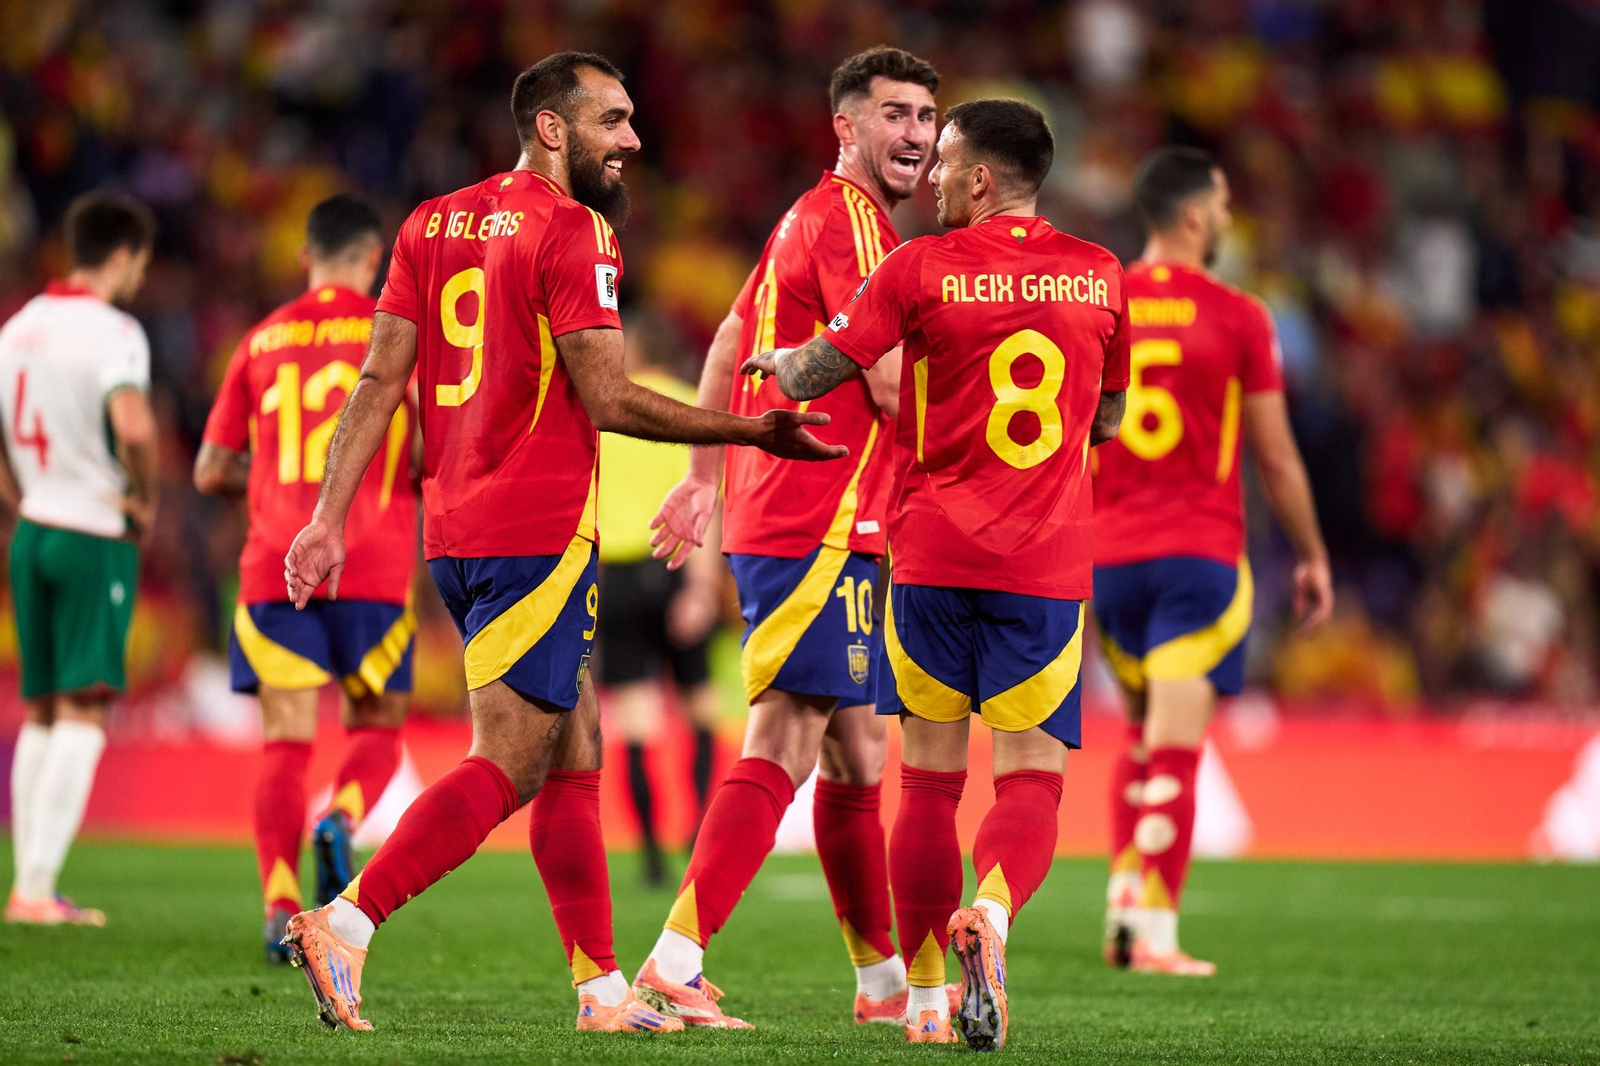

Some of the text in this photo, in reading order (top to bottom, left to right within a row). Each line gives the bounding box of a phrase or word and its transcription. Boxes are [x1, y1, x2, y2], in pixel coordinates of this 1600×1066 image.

[425, 212, 442, 238] B
[436, 267, 485, 407] 9
[942, 269, 1108, 307] ALEIX GARCÍA
[13, 366, 50, 474] 4
[261, 361, 361, 484] 12
[985, 328, 1066, 470] 8
[1117, 338, 1184, 461] 6
[583, 582, 598, 641] 9
[836, 576, 873, 636] 10
